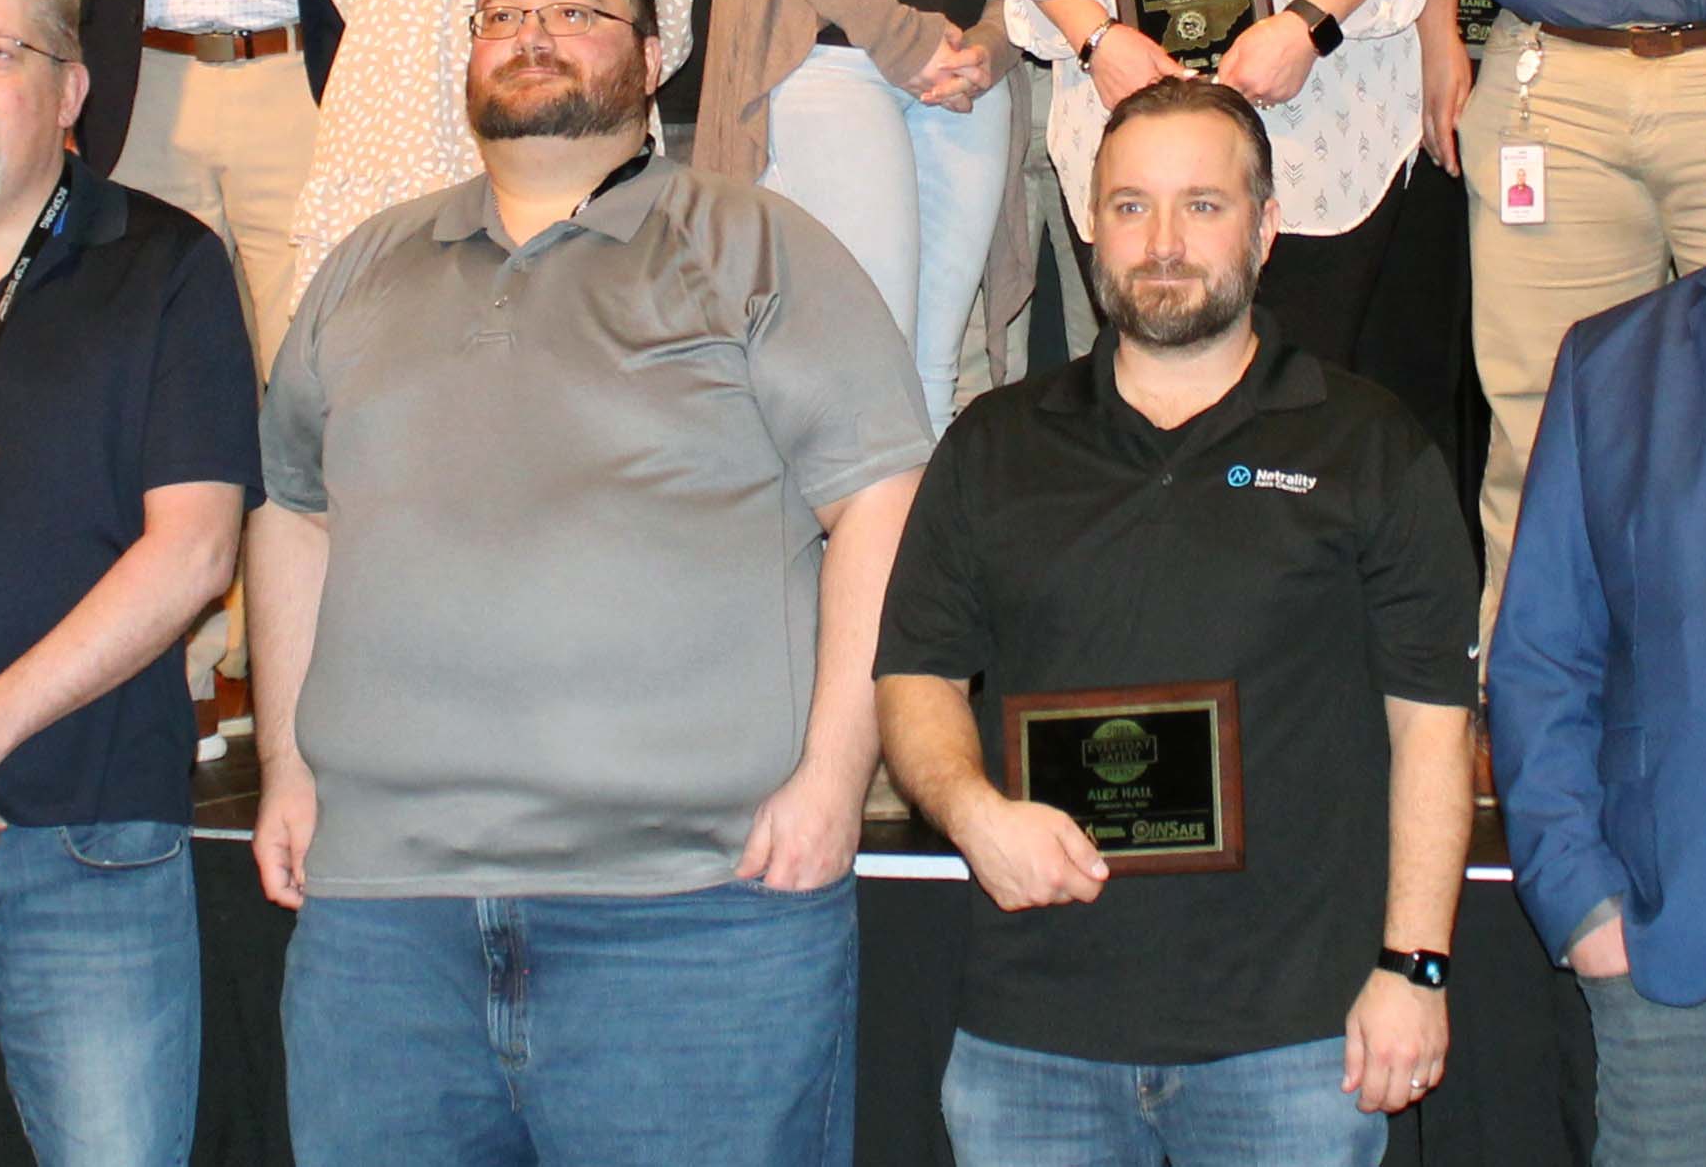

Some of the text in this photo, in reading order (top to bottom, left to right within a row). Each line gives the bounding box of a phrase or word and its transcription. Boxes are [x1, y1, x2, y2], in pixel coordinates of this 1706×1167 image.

[1256, 468, 1317, 489] Netrality
[1087, 786, 1153, 800] ALEX HALL
